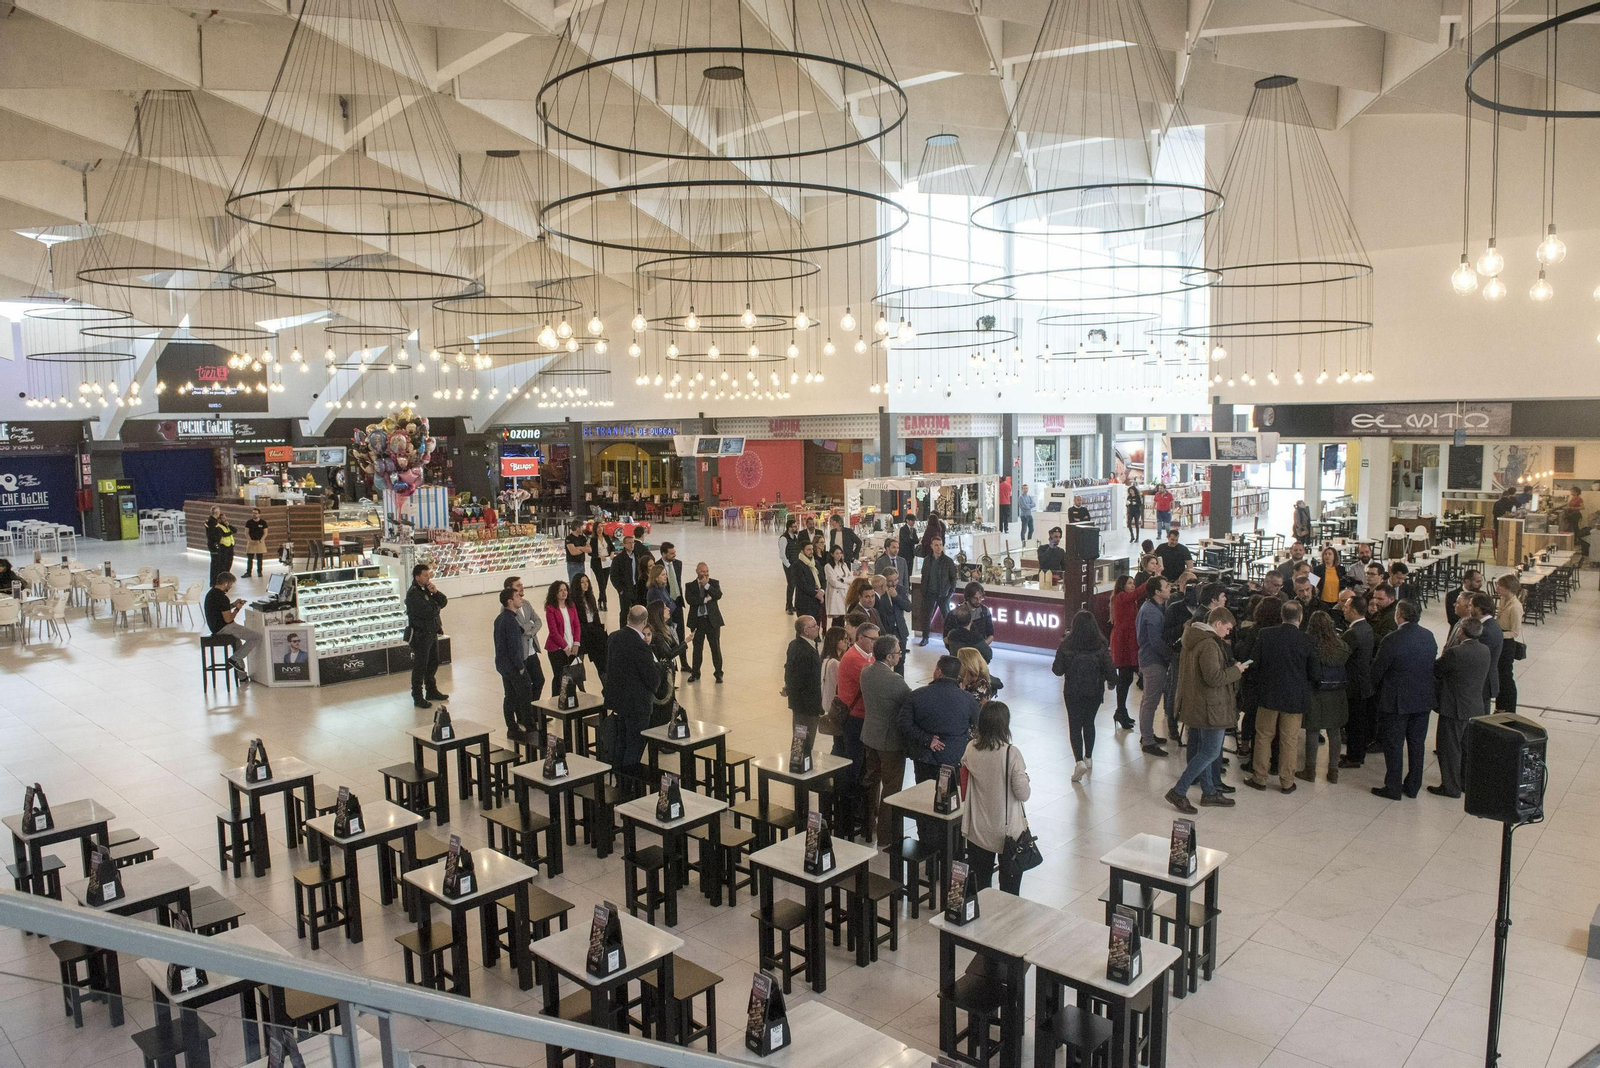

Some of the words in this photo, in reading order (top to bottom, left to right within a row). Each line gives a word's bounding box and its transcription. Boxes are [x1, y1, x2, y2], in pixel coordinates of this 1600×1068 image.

[904, 415, 950, 430] CANTINA
[1351, 413, 1402, 429] EL
[510, 428, 540, 439] ozone
[583, 427, 593, 436] EL
[638, 428, 647, 436] DE
[0, 492, 19, 505] CHE
[1015, 610, 1060, 629] LAND
[343, 660, 364, 670] NYS
